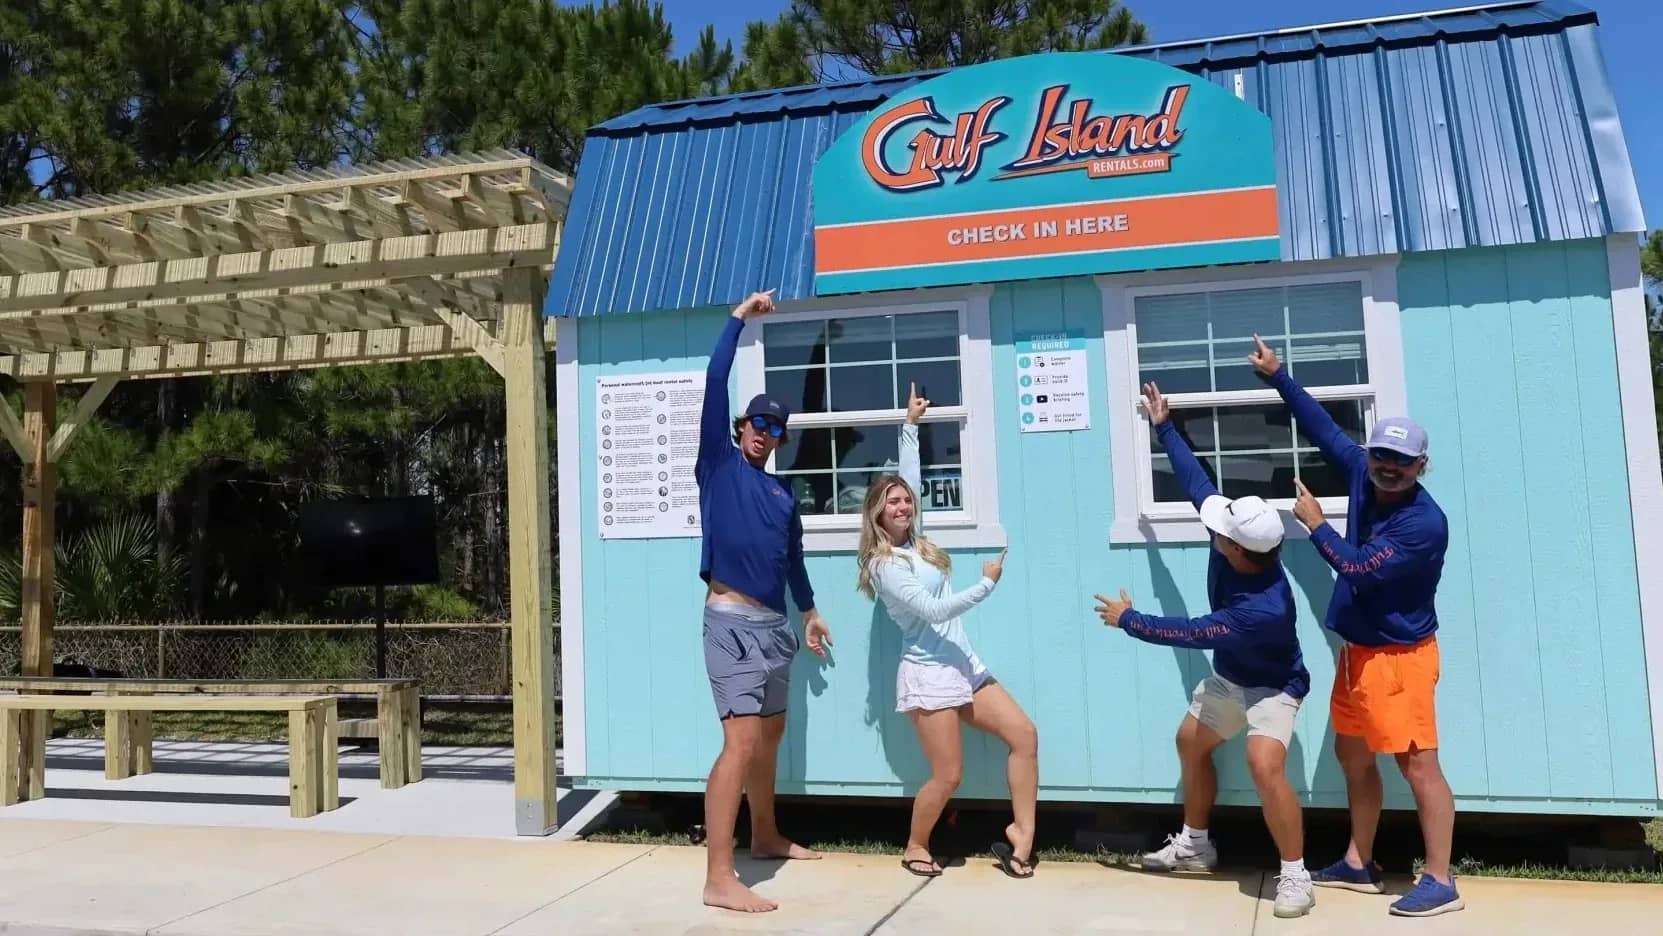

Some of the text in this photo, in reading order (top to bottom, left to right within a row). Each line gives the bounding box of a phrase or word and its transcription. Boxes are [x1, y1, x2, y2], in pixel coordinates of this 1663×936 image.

[862, 84, 1191, 193] Gulf Island
[1093, 158, 1165, 174] RENTALS.com
[947, 214, 1130, 246] CHECK IN HERE
[920, 479, 961, 507] PEN
